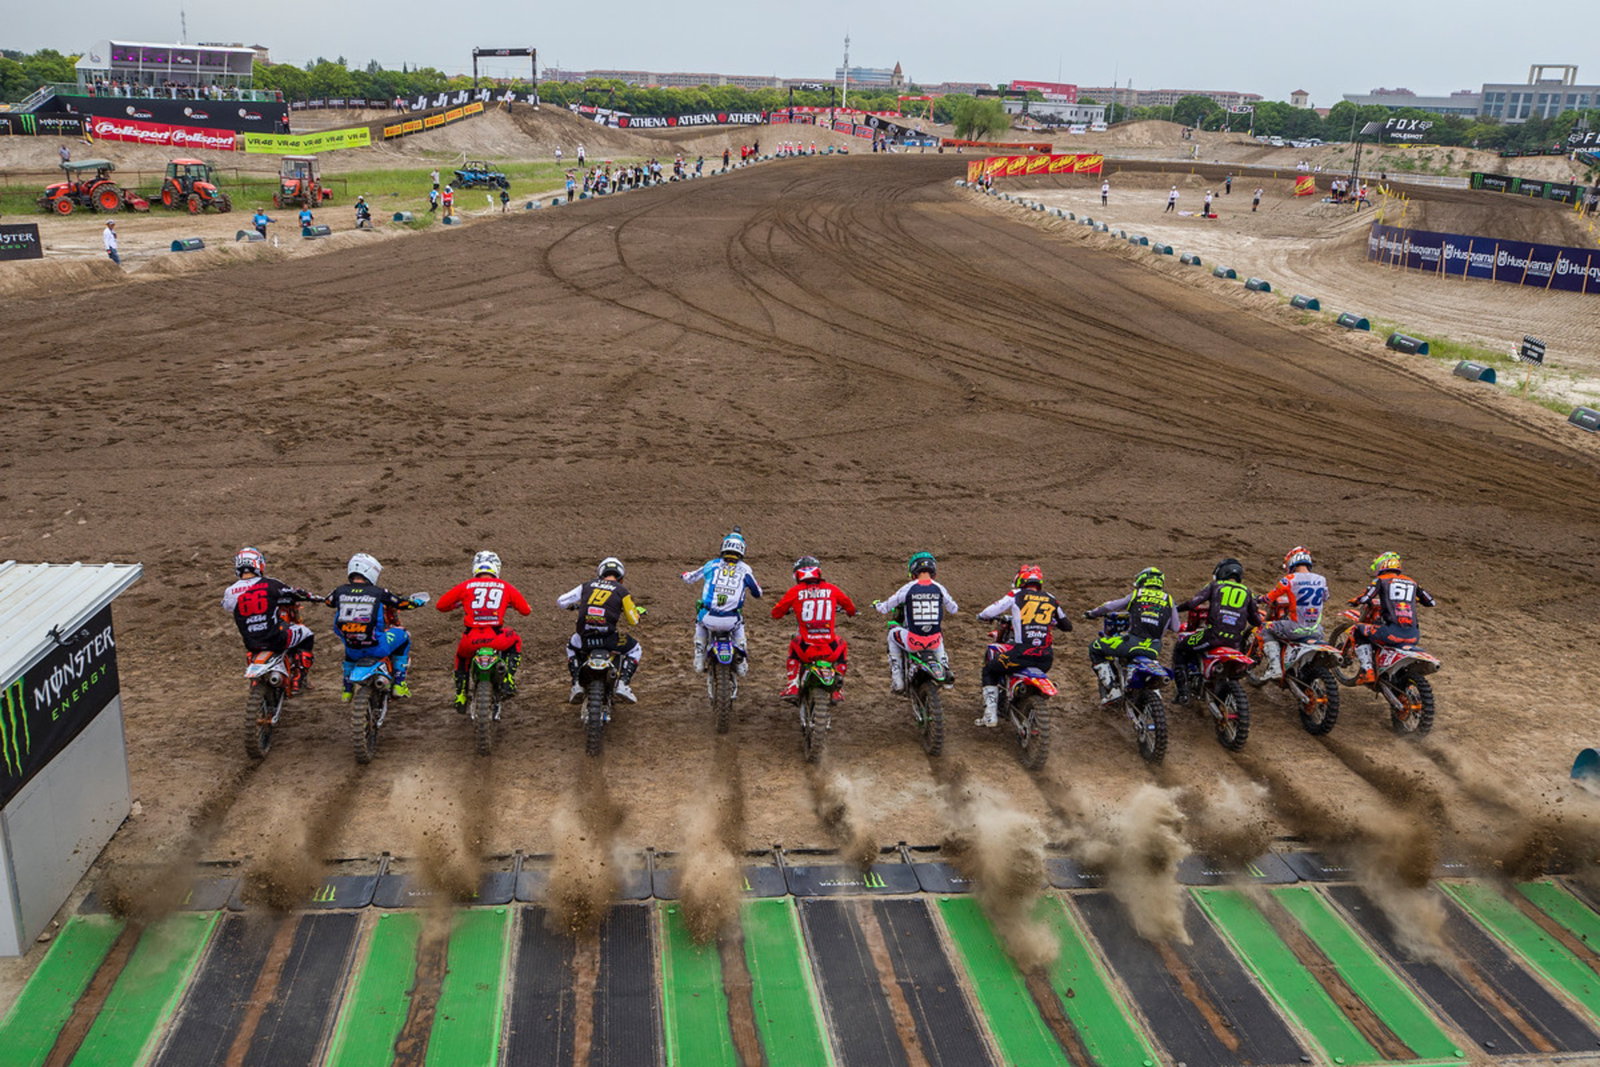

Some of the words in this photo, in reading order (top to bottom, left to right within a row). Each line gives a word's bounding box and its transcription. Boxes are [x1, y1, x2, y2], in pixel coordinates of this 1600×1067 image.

[629, 117, 668, 127] ATHENA
[678, 113, 717, 125] ATHENA
[1385, 118, 1420, 131] FOX
[96, 121, 170, 140] Polisport
[172, 129, 234, 145] Polisport
[1453, 248, 1495, 262] Husqvarna
[1507, 255, 1553, 272] Husqvarna
[471, 587, 503, 609] 39
[587, 588, 612, 606] 19
[798, 588, 832, 600] STRY
[1220, 586, 1248, 608] 10
[1389, 582, 1415, 602] 61
[237, 590, 268, 617] 66
[801, 599, 832, 622] 811
[912, 600, 940, 620] 225
[1020, 600, 1056, 625] 43
[33, 625, 116, 711] MONSTER
[51, 663, 108, 721] ENERGY
